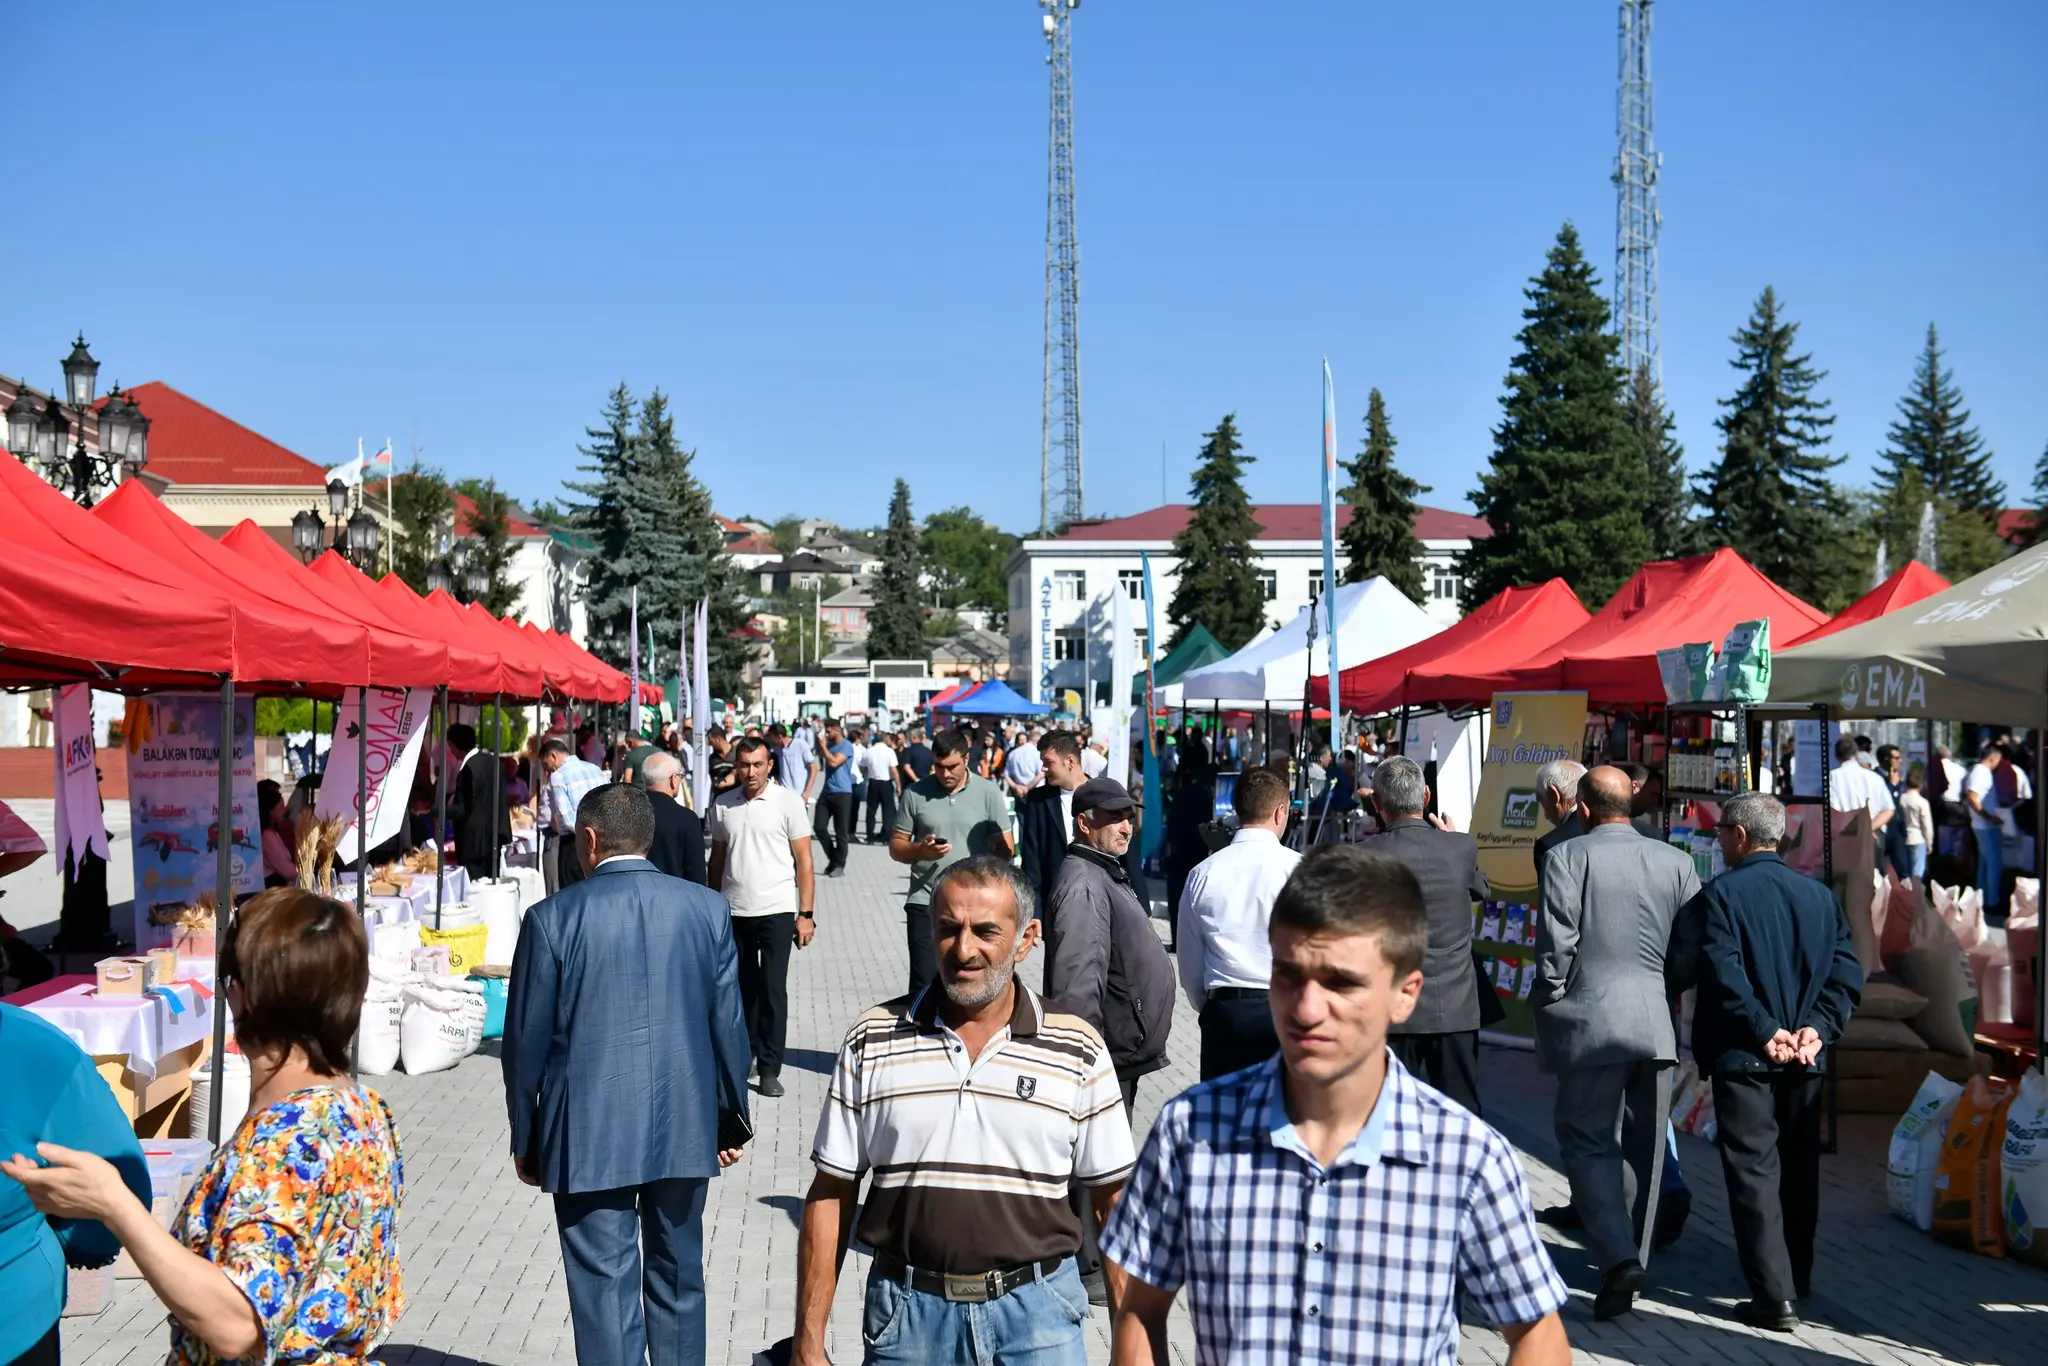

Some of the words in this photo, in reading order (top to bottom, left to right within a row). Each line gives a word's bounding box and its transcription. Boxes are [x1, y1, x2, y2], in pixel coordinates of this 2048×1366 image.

[1913, 599, 2002, 624] EMA
[1865, 664, 1926, 708] EMA
[402, 711, 413, 735] SEEDS
[143, 747, 187, 761] BALAKƏN
[190, 746, 220, 761] TOXUM
[440, 1024, 465, 1038] ARPA
